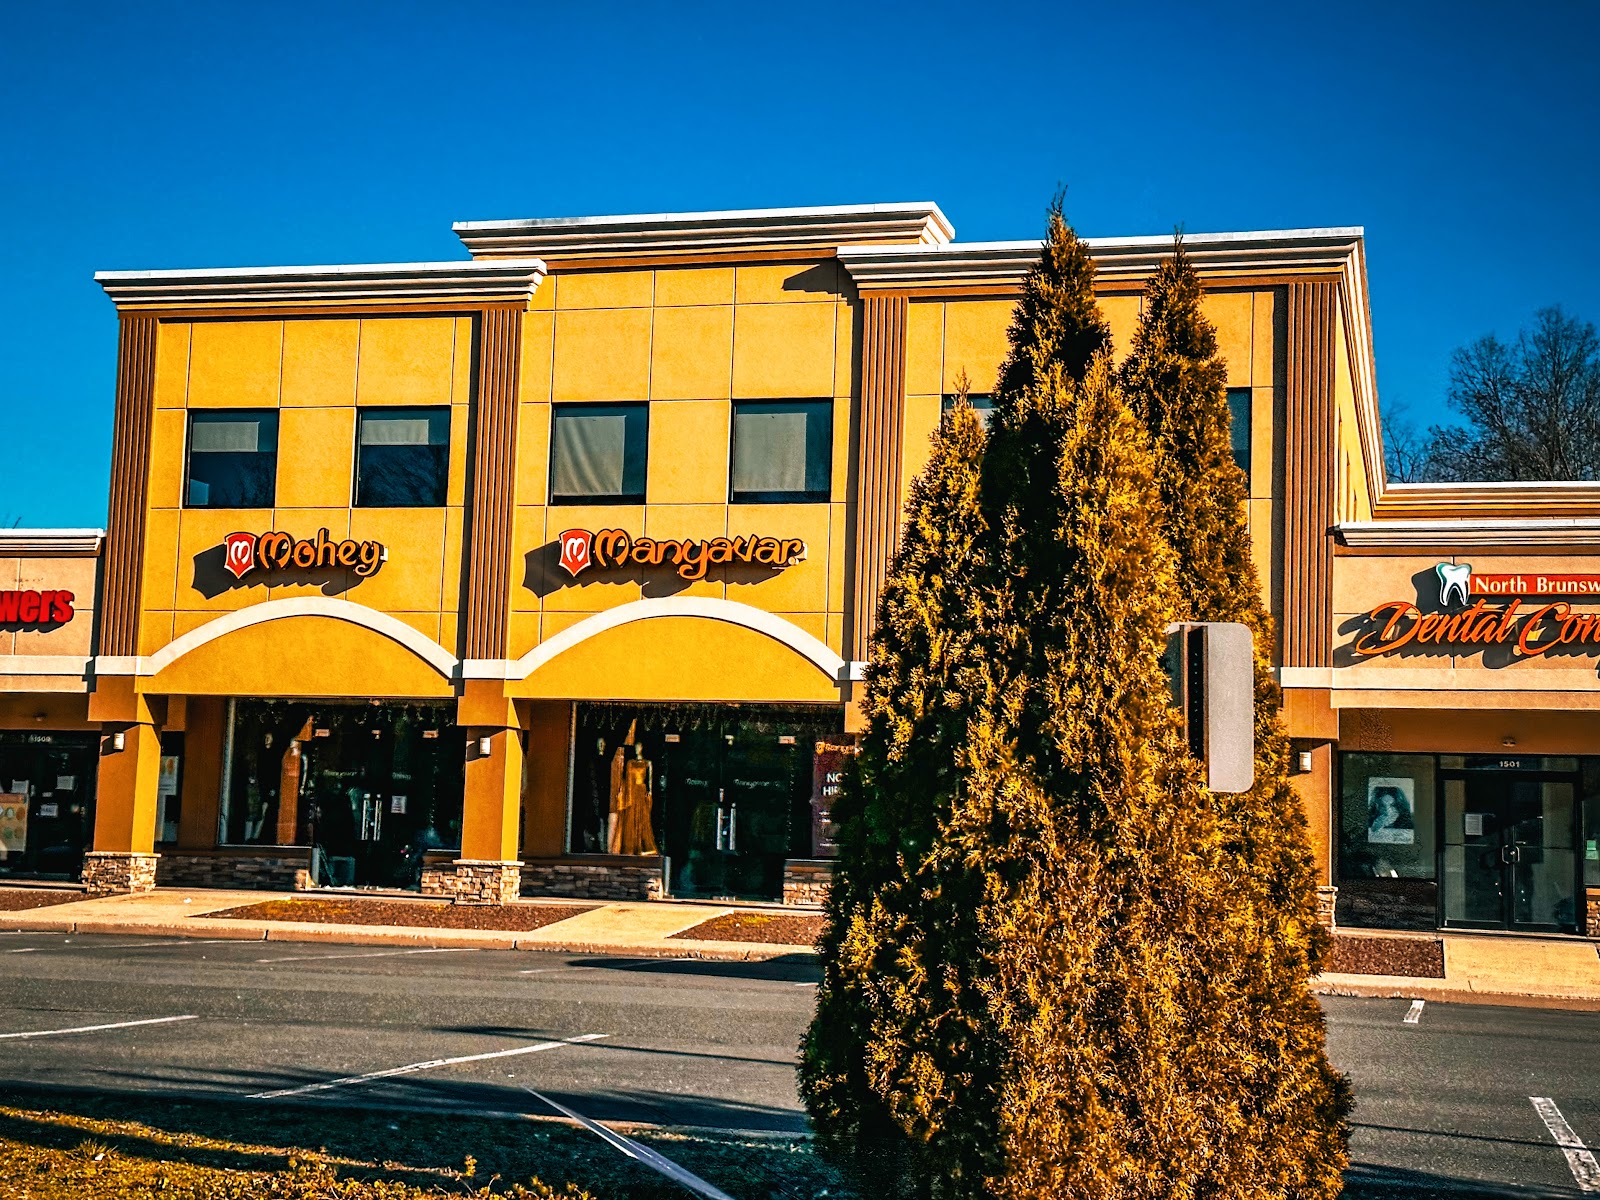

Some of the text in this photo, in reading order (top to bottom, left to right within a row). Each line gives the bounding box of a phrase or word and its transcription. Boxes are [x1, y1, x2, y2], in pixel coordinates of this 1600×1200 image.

[258, 528, 384, 577] Mohey
[595, 529, 803, 580] Manyavar
[1474, 576, 1600, 593] North Brunsw
[1355, 598, 1522, 655] Dental
[1499, 760, 1520, 768] 1501
